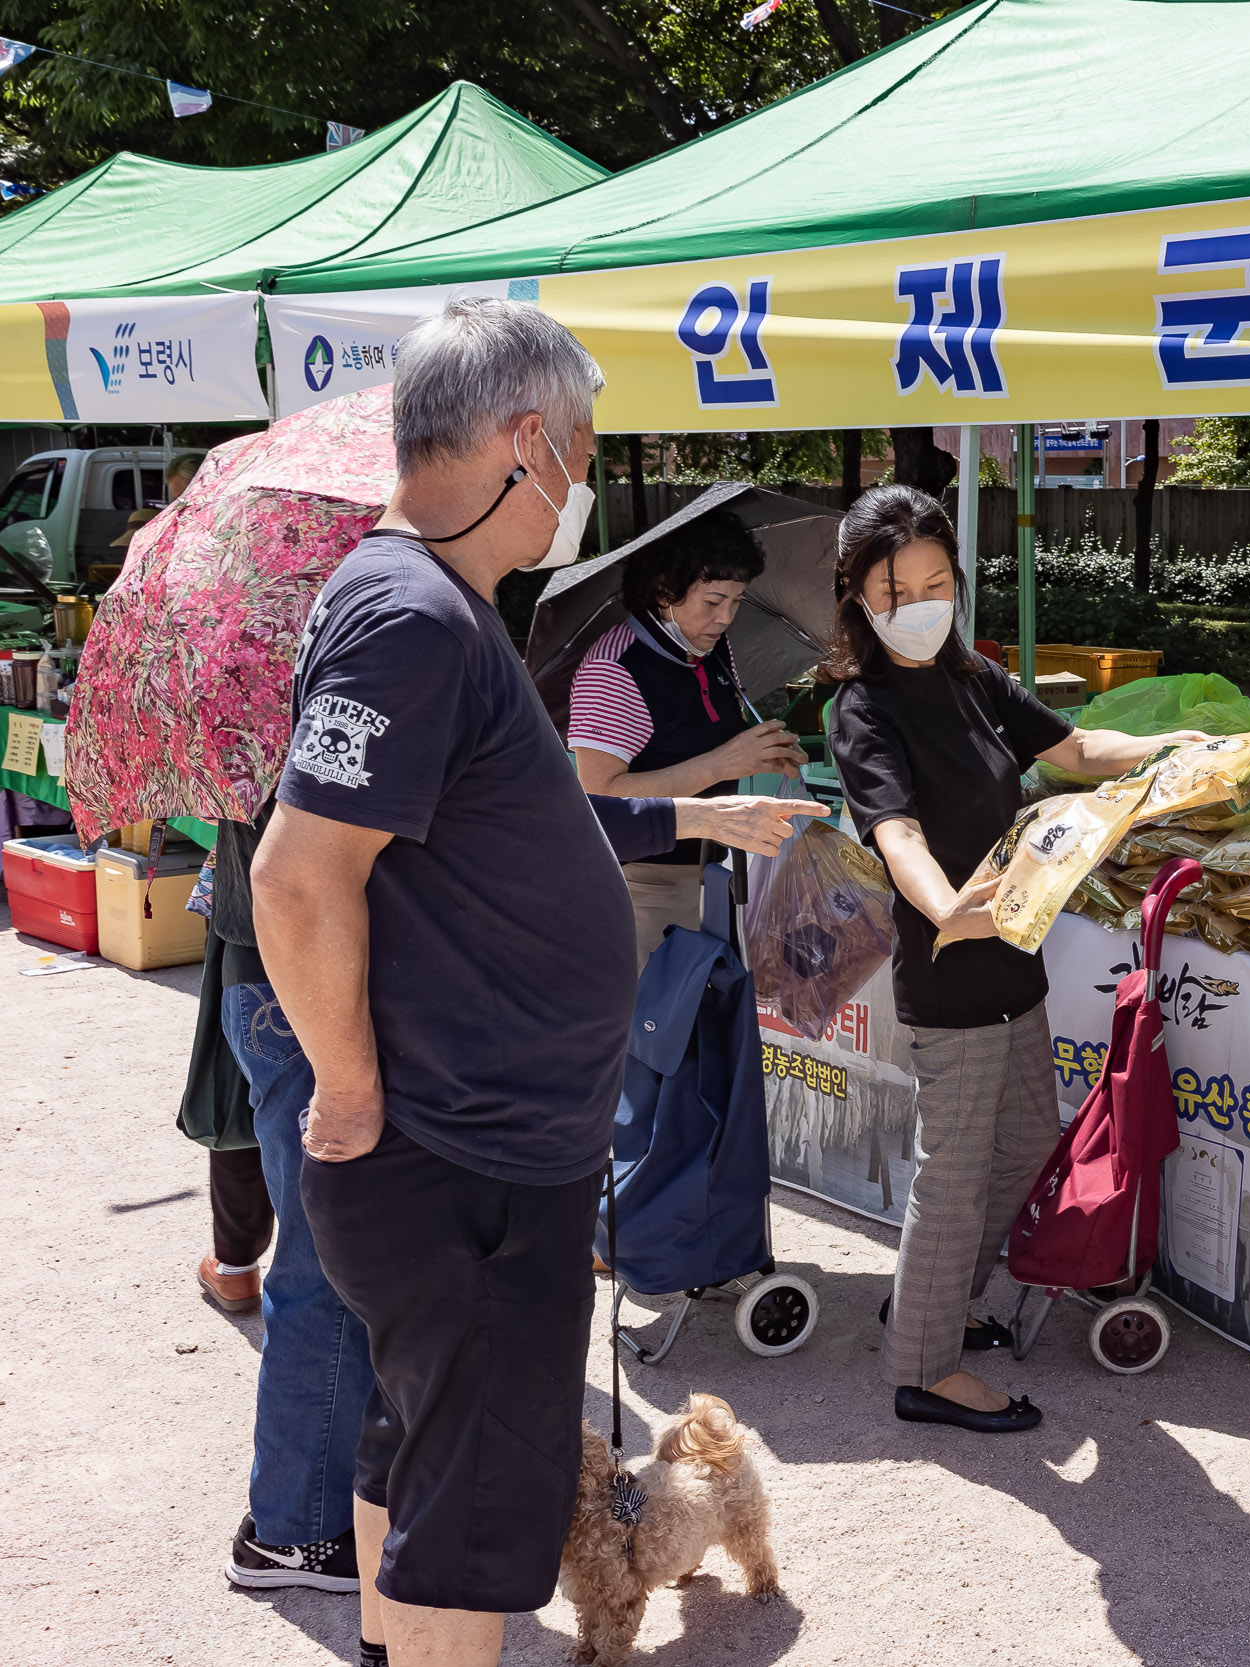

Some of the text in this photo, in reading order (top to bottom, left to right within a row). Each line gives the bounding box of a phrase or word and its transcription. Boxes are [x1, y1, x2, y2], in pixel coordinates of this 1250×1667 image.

[137, 339, 195, 385] 보령시
[341, 341, 386, 371] 소통하며
[309, 695, 390, 737] 88TEES
[348, 775, 360, 787] HI
